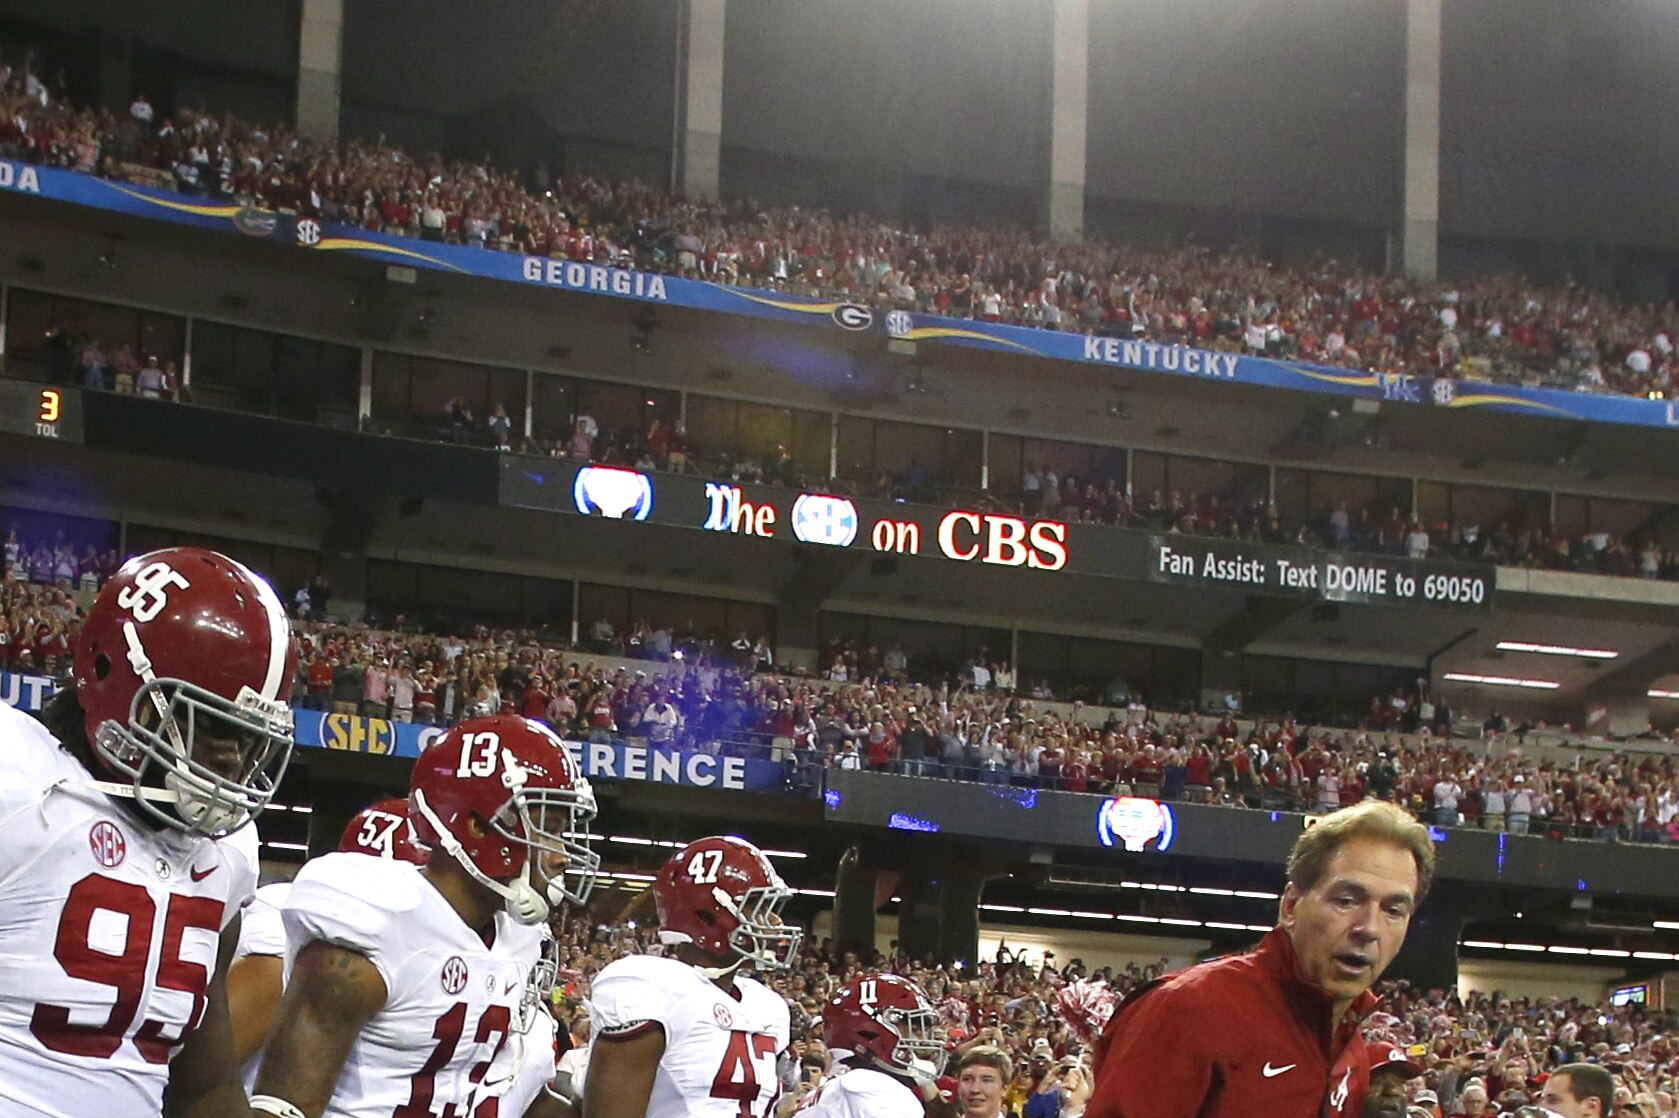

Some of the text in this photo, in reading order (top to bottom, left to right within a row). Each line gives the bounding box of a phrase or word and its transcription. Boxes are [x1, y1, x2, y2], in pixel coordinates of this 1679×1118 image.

[523, 258, 667, 300] GEORGIA
[1084, 336, 1238, 377] KENTUCKY
[40, 390, 60, 422] 3
[36, 422, 59, 439] TOL
[704, 482, 775, 538] The
[872, 517, 920, 555] on
[938, 511, 1069, 572] CBS
[117, 561, 191, 623] 95
[1159, 546, 1485, 604] Fan Assist: Text DOME to 69050
[325, 712, 389, 755] SEC
[456, 731, 501, 779] 13
[357, 809, 404, 860] 57
[687, 850, 723, 884] 47
[29, 872, 226, 1065] 95
[441, 955, 469, 995] SEC
[859, 981, 878, 1004] 11
